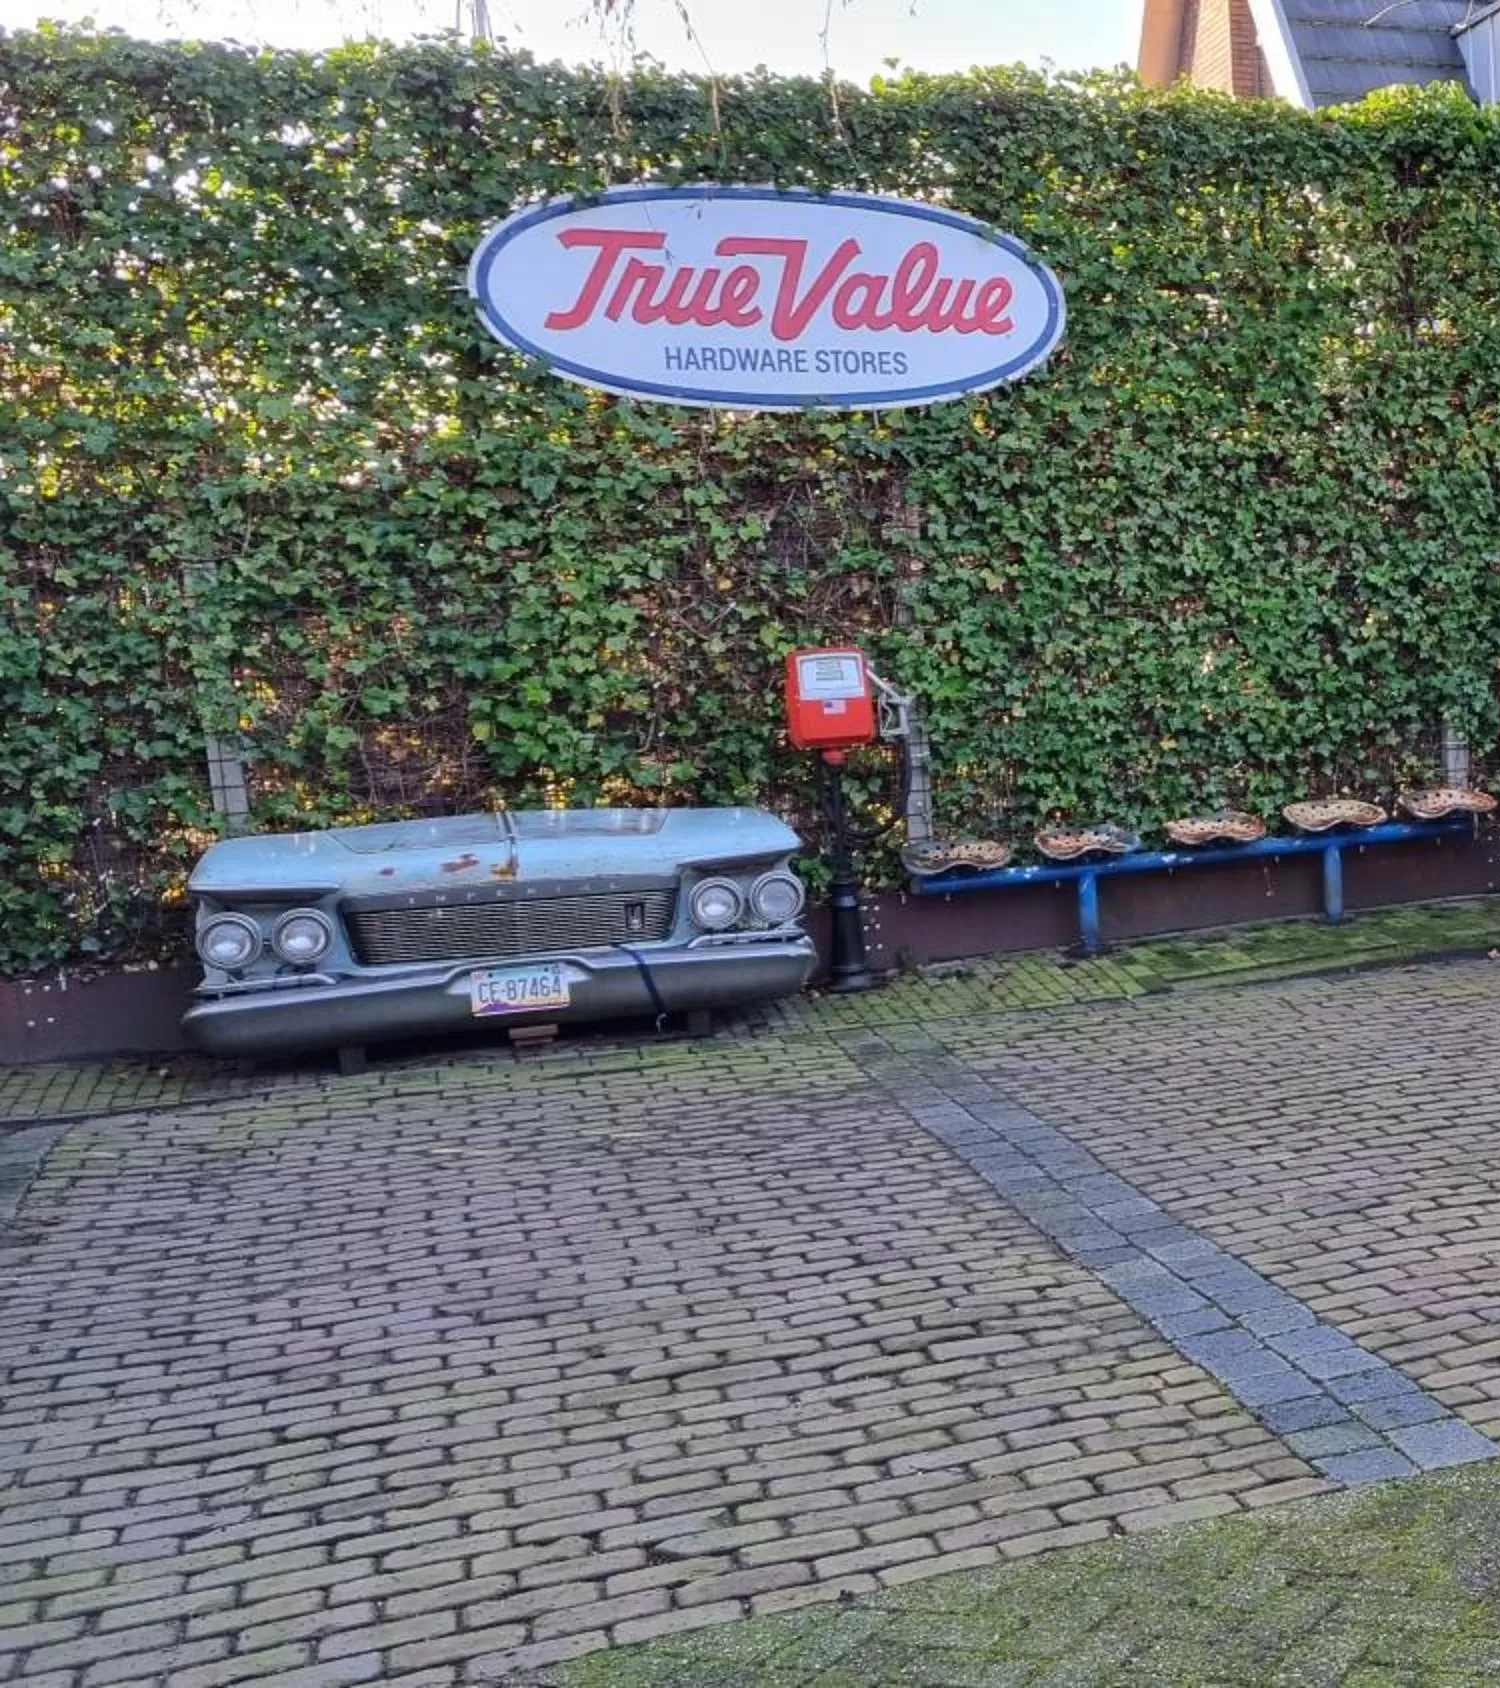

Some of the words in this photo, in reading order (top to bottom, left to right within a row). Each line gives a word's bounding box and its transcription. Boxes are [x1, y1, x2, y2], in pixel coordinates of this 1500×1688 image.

[543, 228, 763, 331] True
[715, 236, 1014, 342] Value
[665, 346, 807, 374] HARDWARE
[815, 350, 909, 375] STORES
